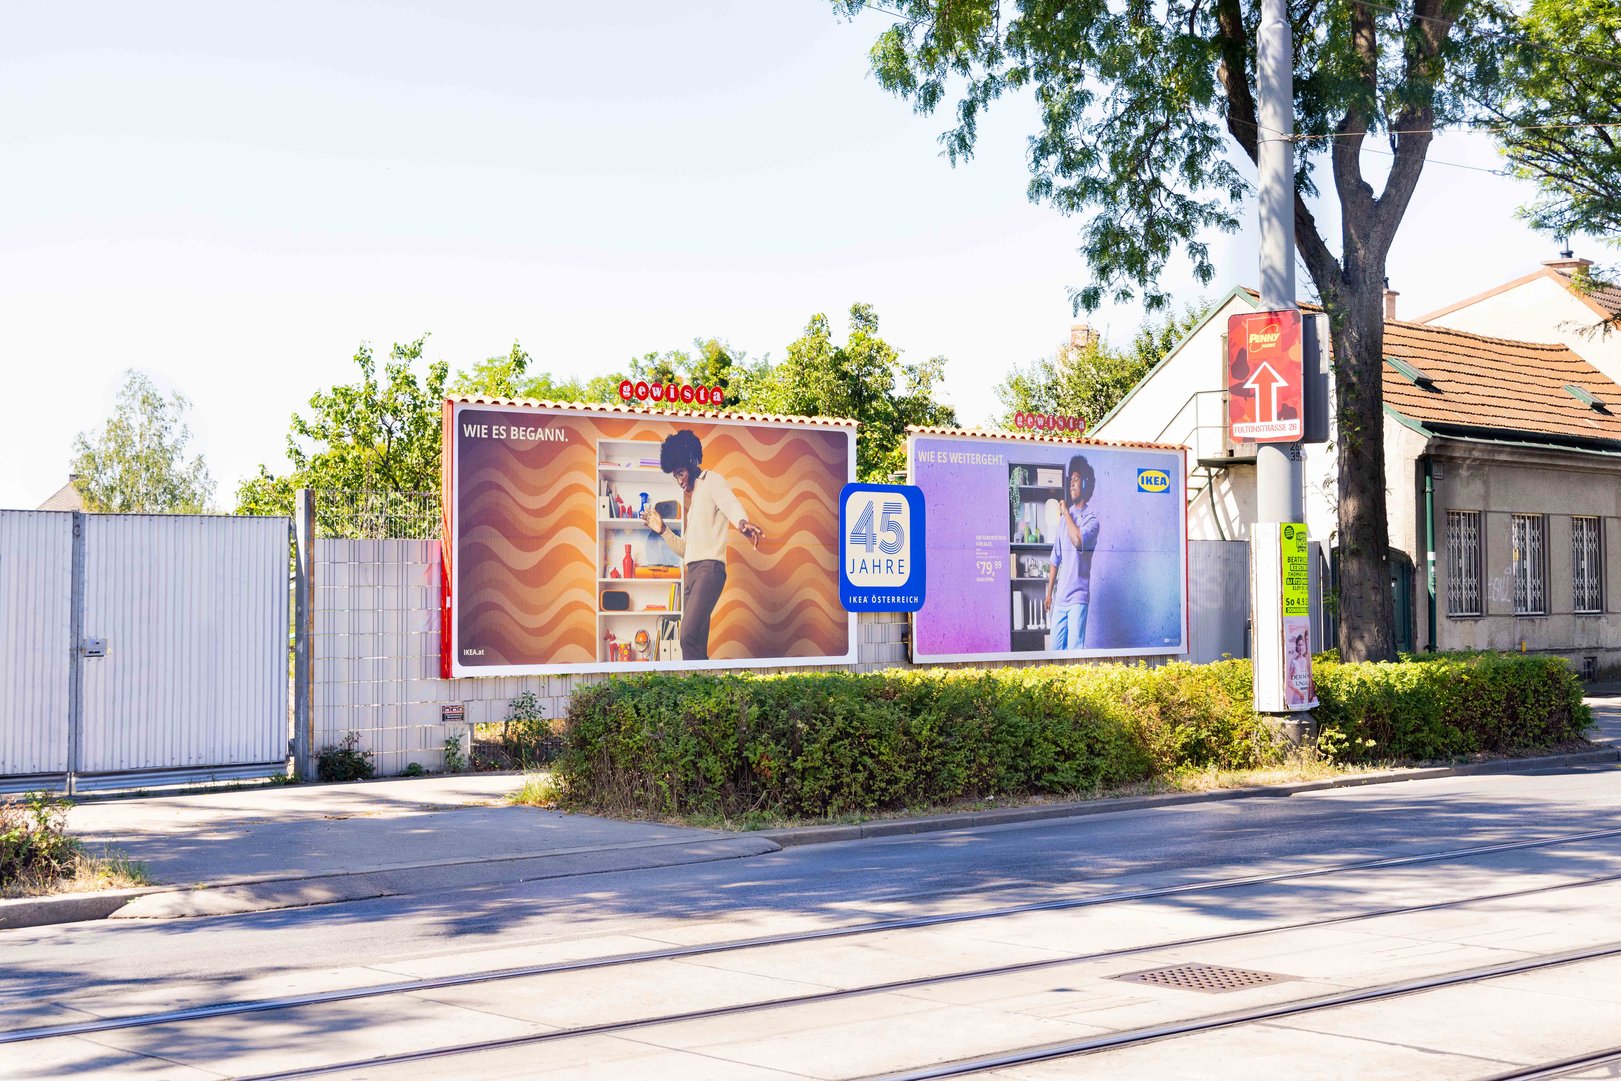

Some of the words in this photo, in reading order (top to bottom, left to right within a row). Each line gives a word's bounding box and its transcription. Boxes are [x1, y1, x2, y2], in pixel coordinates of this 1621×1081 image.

[1249, 333, 1280, 344] PENNY
[620, 383, 722, 403] gewista
[1015, 411, 1085, 431] gewista
[1234, 423, 1287, 434] FULTONSTRASSE
[1288, 423, 1297, 431] 26
[463, 423, 489, 438] WIE
[492, 425, 507, 439] ES
[510, 426, 569, 442] BEGANN.
[917, 450, 935, 463] WIE
[937, 451, 948, 463] ES
[950, 452, 1006, 466] WEITERGEHT.
[1141, 475, 1167, 486] IKEA
[849, 500, 905, 555] 45
[849, 558, 905, 575] JAHRE
[871, 593, 919, 604] ÖSTERREICH
[1285, 597, 1295, 606] So
